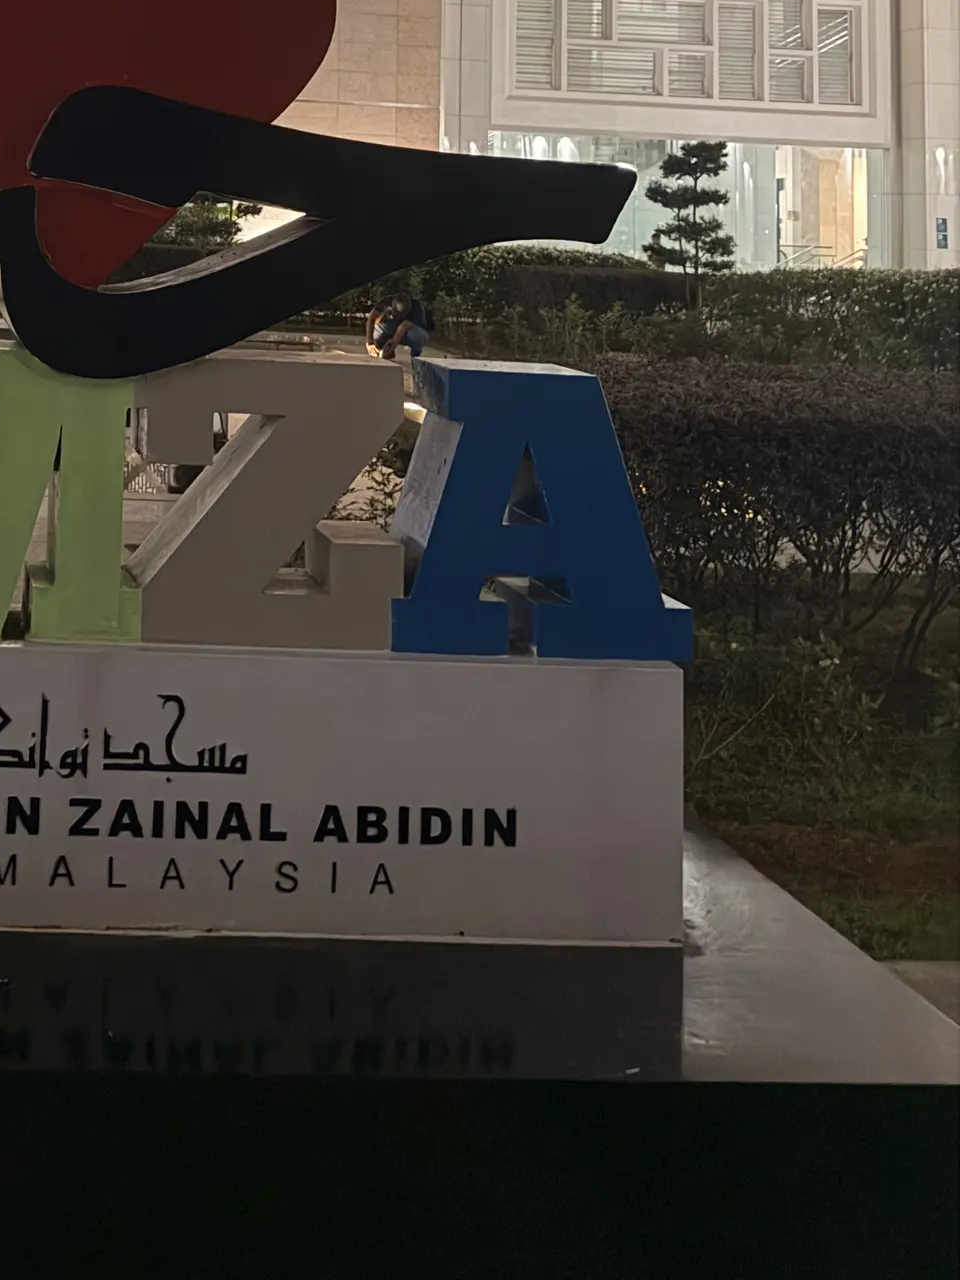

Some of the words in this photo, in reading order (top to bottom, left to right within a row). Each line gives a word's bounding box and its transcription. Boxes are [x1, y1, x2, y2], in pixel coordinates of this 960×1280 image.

[102, 694, 249, 784] مسجد
[68, 797, 288, 842] ZAINAL
[312, 804, 517, 848] ABIDIN
